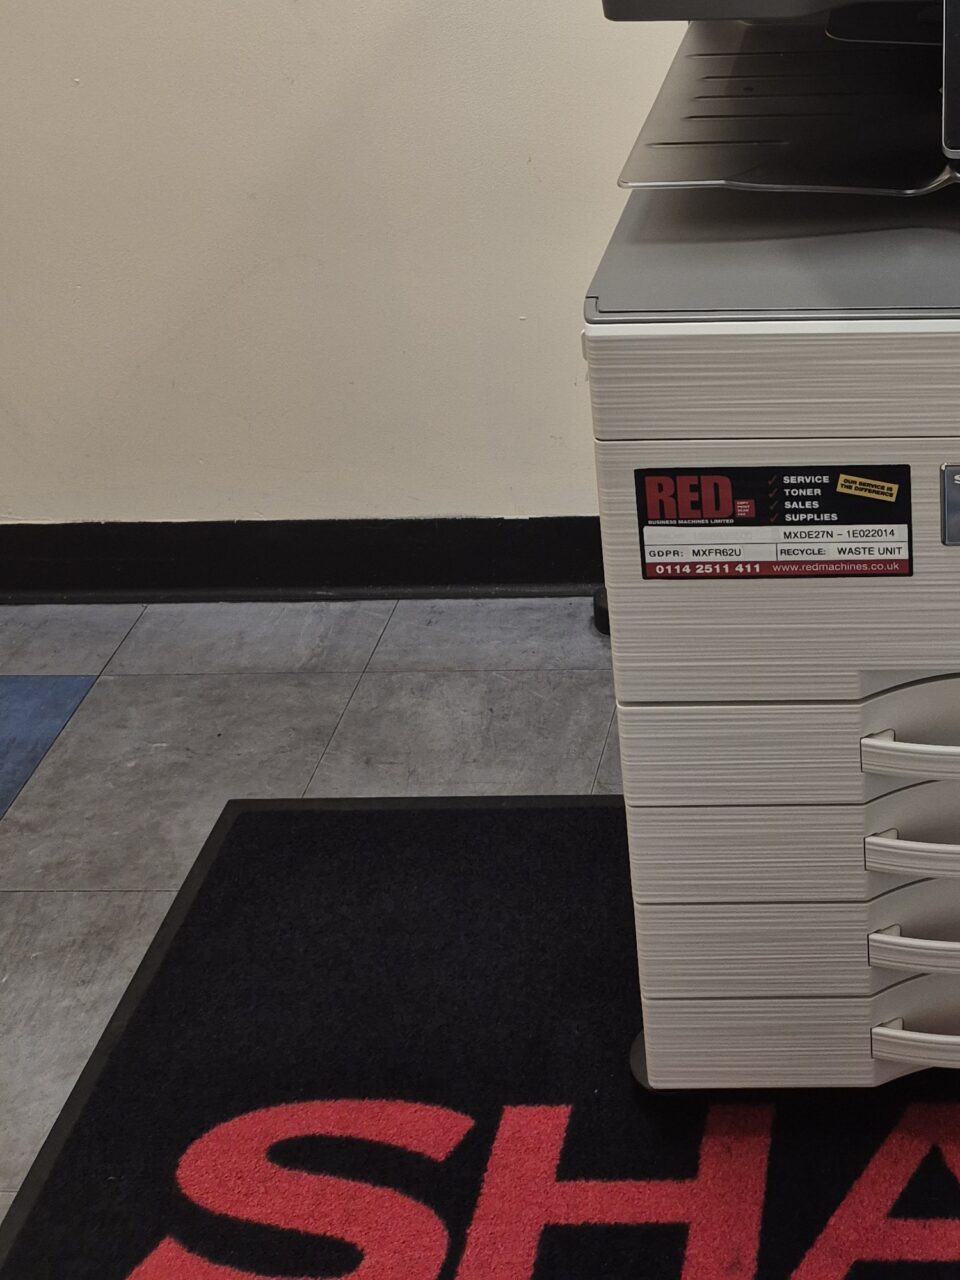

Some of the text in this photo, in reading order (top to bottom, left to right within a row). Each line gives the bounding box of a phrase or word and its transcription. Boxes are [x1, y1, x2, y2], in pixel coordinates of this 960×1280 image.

[783, 476, 830, 484] SERVICE
[858, 481, 885, 490] SERVICE
[854, 486, 894, 497] DIFFERENCE
[644, 475, 734, 519] RED
[784, 501, 819, 509] SALES
[785, 513, 838, 521] SUPPLIES
[783, 530, 833, 539] MXDE27N
[847, 529, 895, 538] 1E022014
[649, 547, 902, 557] GDPR: MXFR62U RECYCLE: WASTE UNIT
[656, 562, 900, 574] 0114 2511 411 www.redmachines.co.uk
